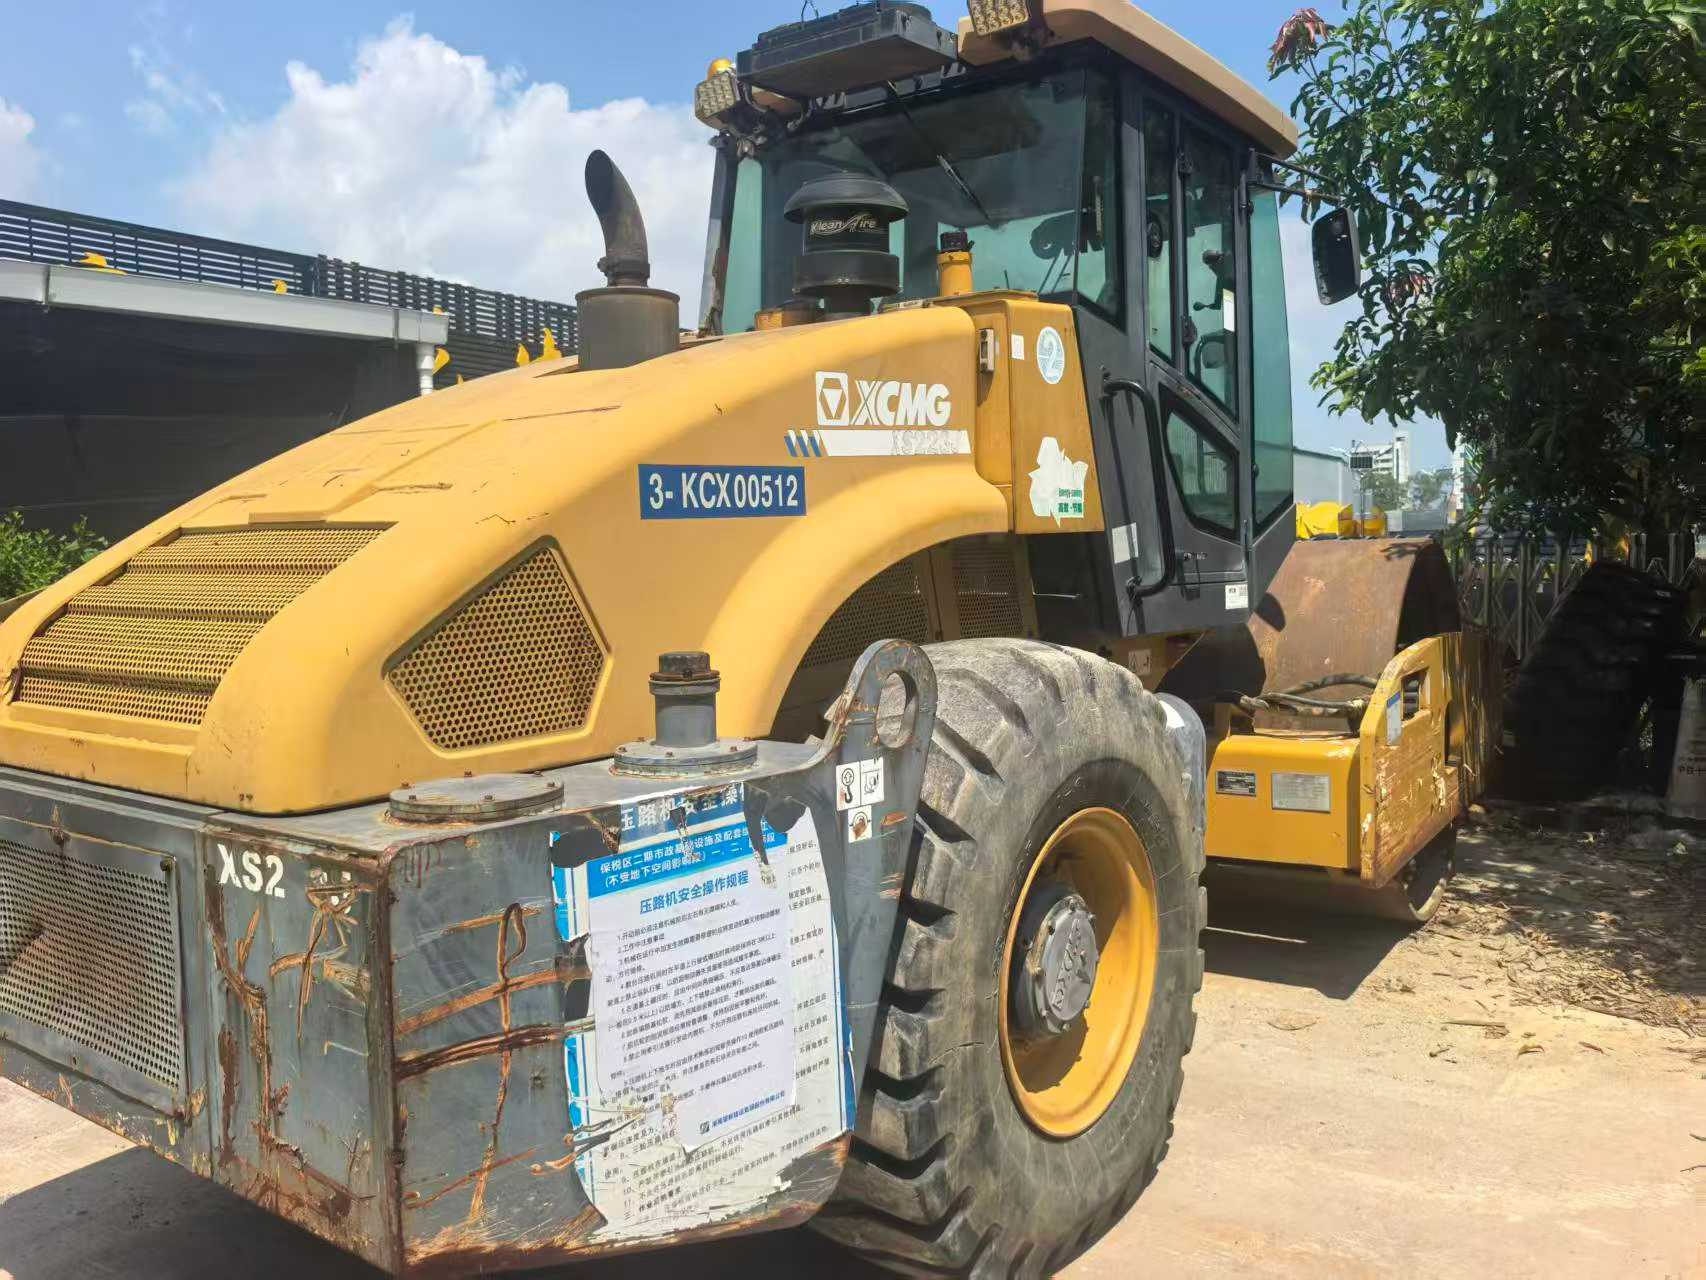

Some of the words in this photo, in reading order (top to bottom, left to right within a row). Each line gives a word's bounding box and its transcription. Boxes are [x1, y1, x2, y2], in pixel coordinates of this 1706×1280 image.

[850, 380, 952, 427] XCMG
[682, 472, 799, 509] KCX00512
[639, 869, 750, 916] 压路机安全操作规程
